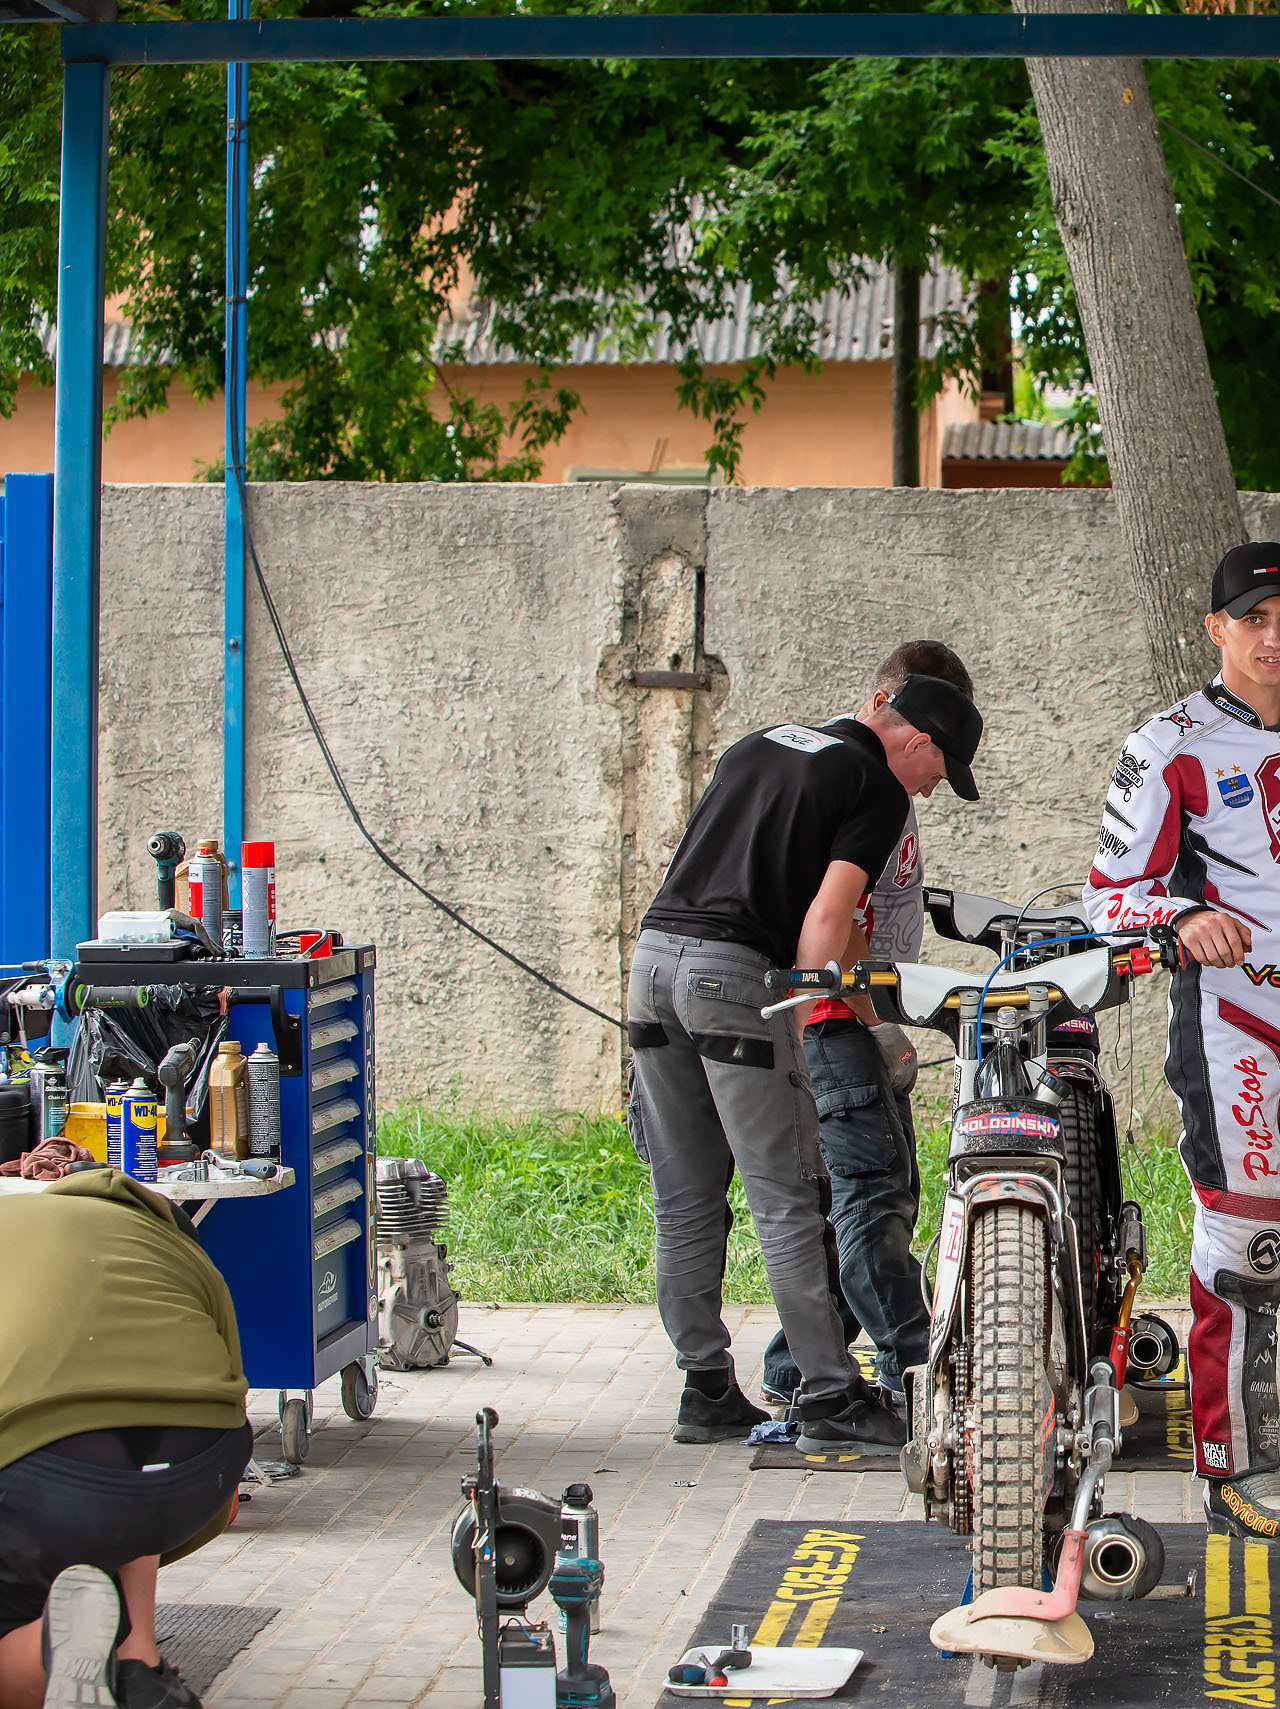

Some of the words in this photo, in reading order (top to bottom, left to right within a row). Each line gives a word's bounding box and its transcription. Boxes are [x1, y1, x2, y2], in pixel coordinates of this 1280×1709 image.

[1232, 1055, 1279, 1181] PitStop
[1202, 1441, 1226, 1452] MALI
[1221, 1484, 1279, 1537] daytona
